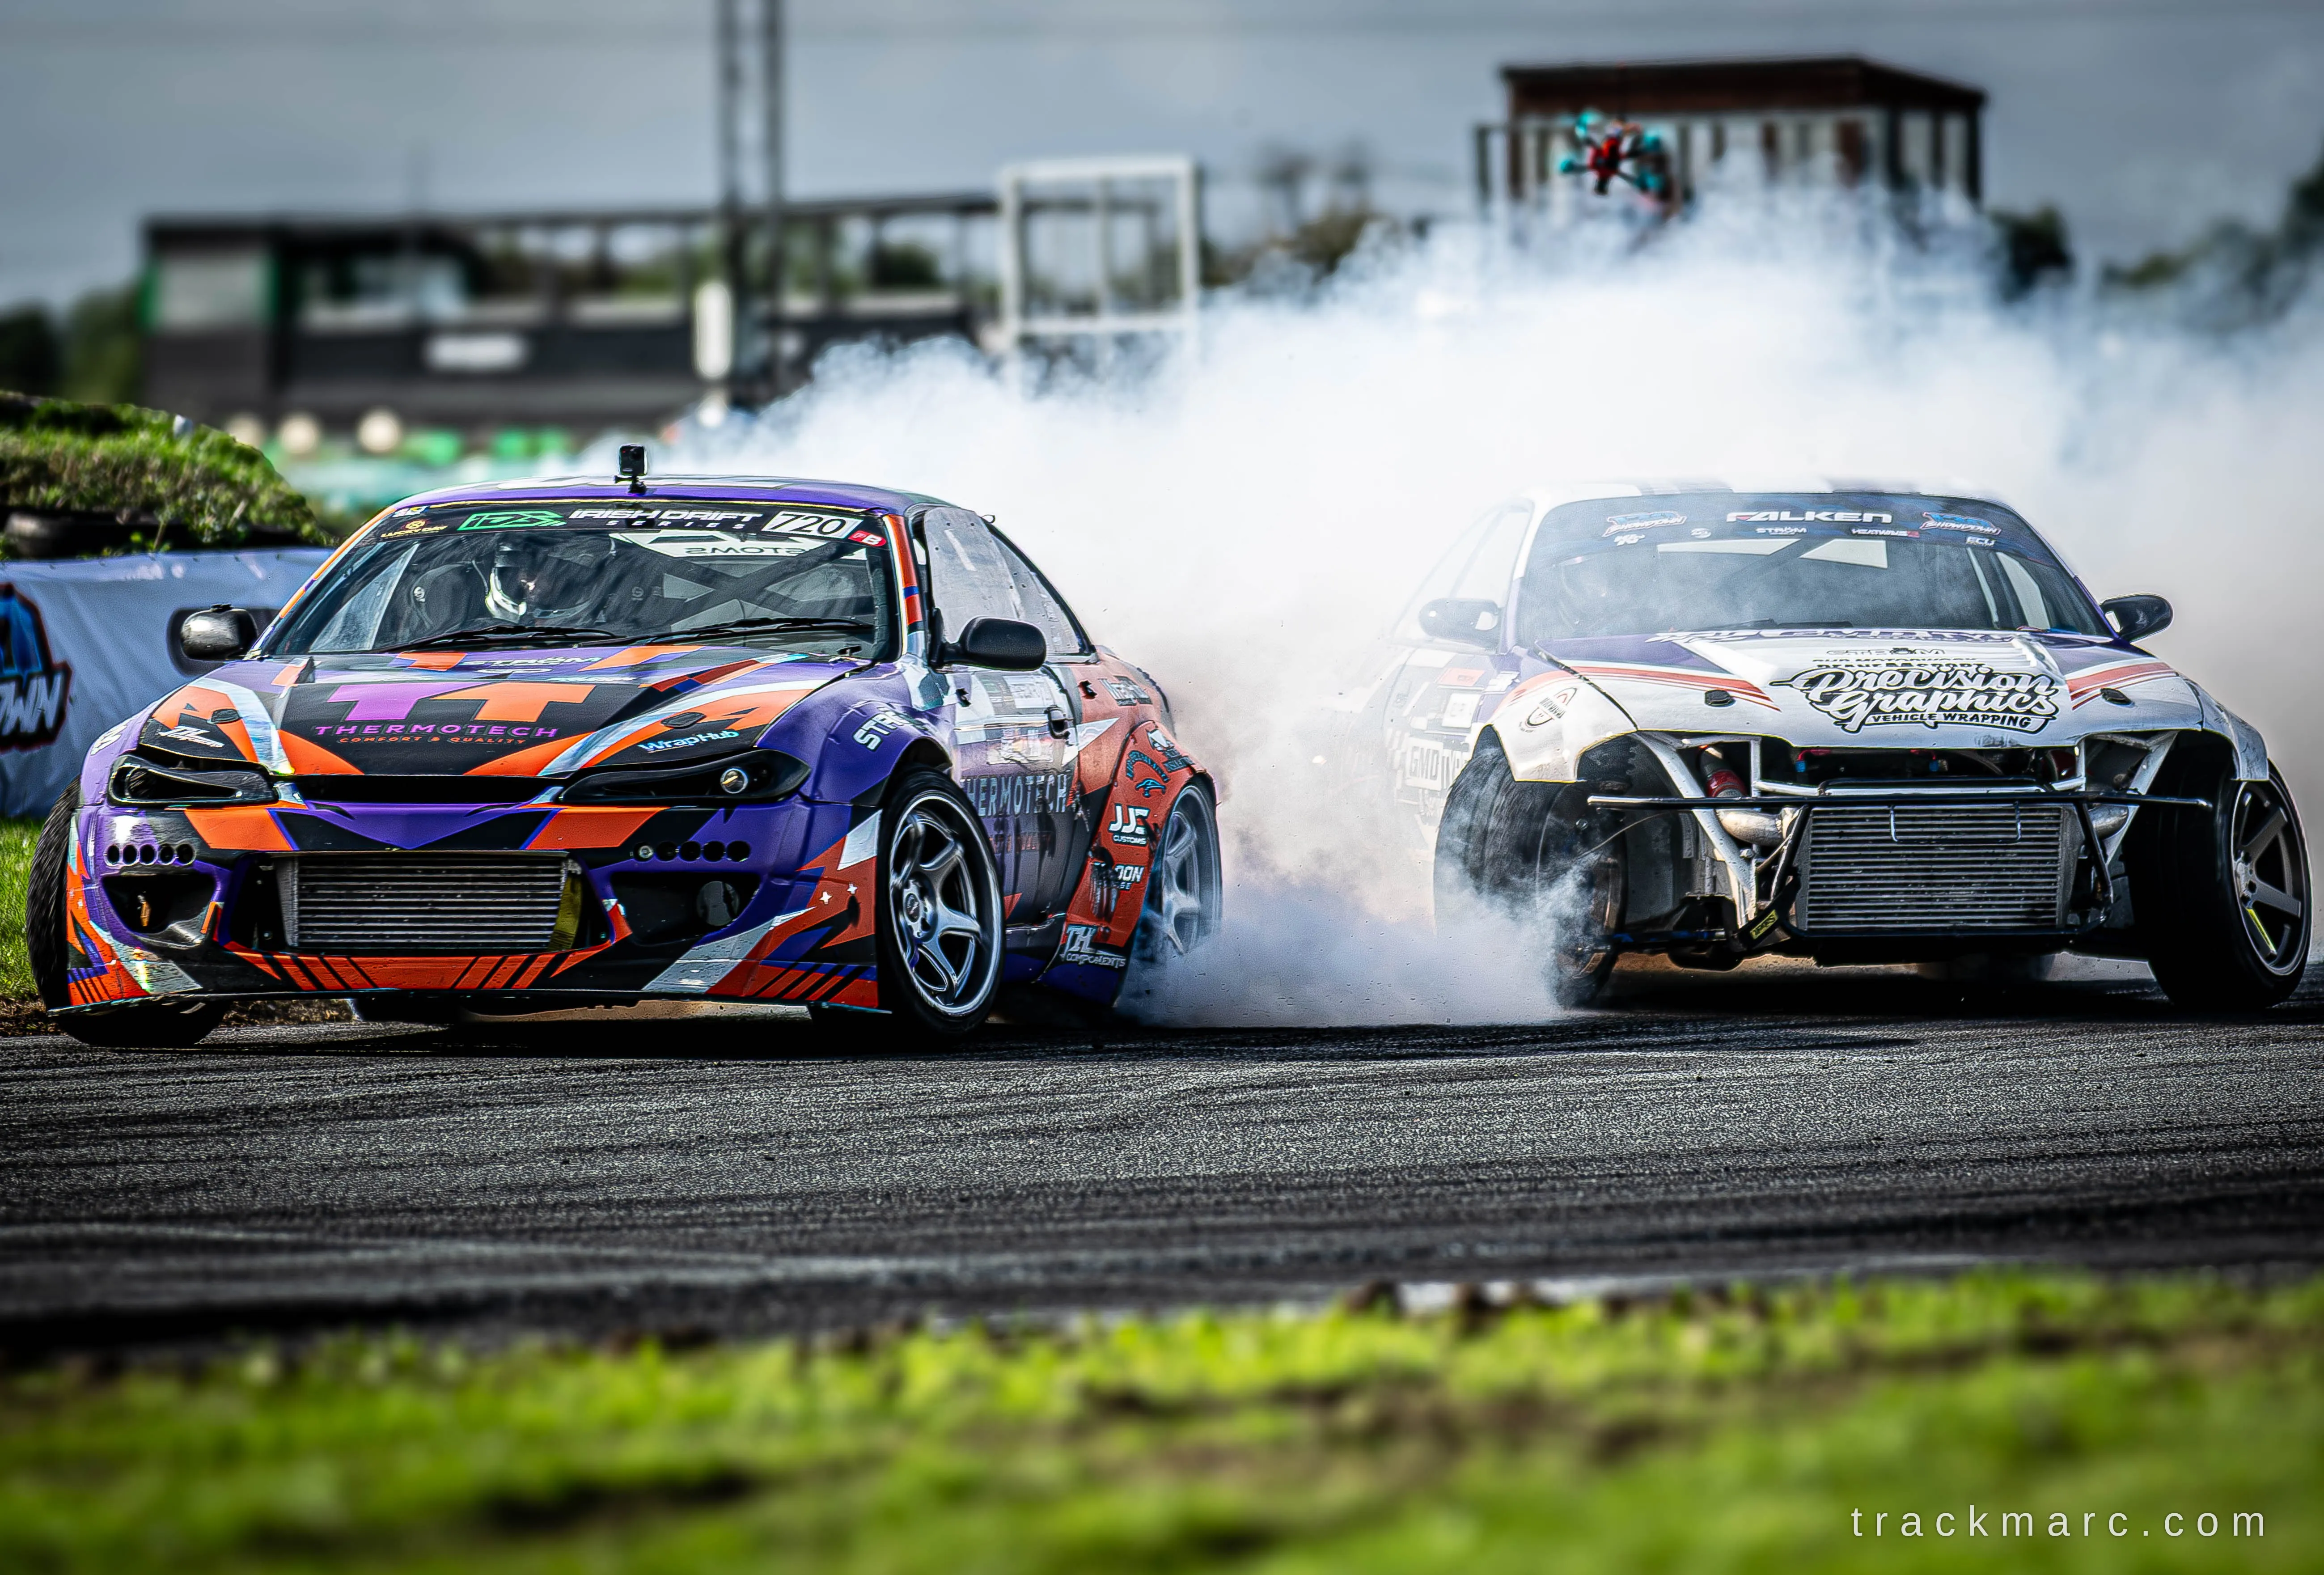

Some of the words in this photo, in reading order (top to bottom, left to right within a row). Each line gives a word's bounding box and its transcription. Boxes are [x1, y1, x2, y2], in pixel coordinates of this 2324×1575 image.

[568, 509, 661, 519] IRISH
[658, 510, 763, 522] DRIFT
[1727, 511, 1892, 523] FALKEN
[605, 520, 745, 529] SERIES
[768, 513, 847, 535] 720
[1789, 667, 2057, 703] Precision
[1813, 688, 2058, 732] Graphics
[1872, 713, 1936, 722] VEHICLE
[1942, 713, 2032, 727] WRAPPING
[315, 724, 559, 737] THERMOTECH
[637, 730, 740, 751] WrapHub
